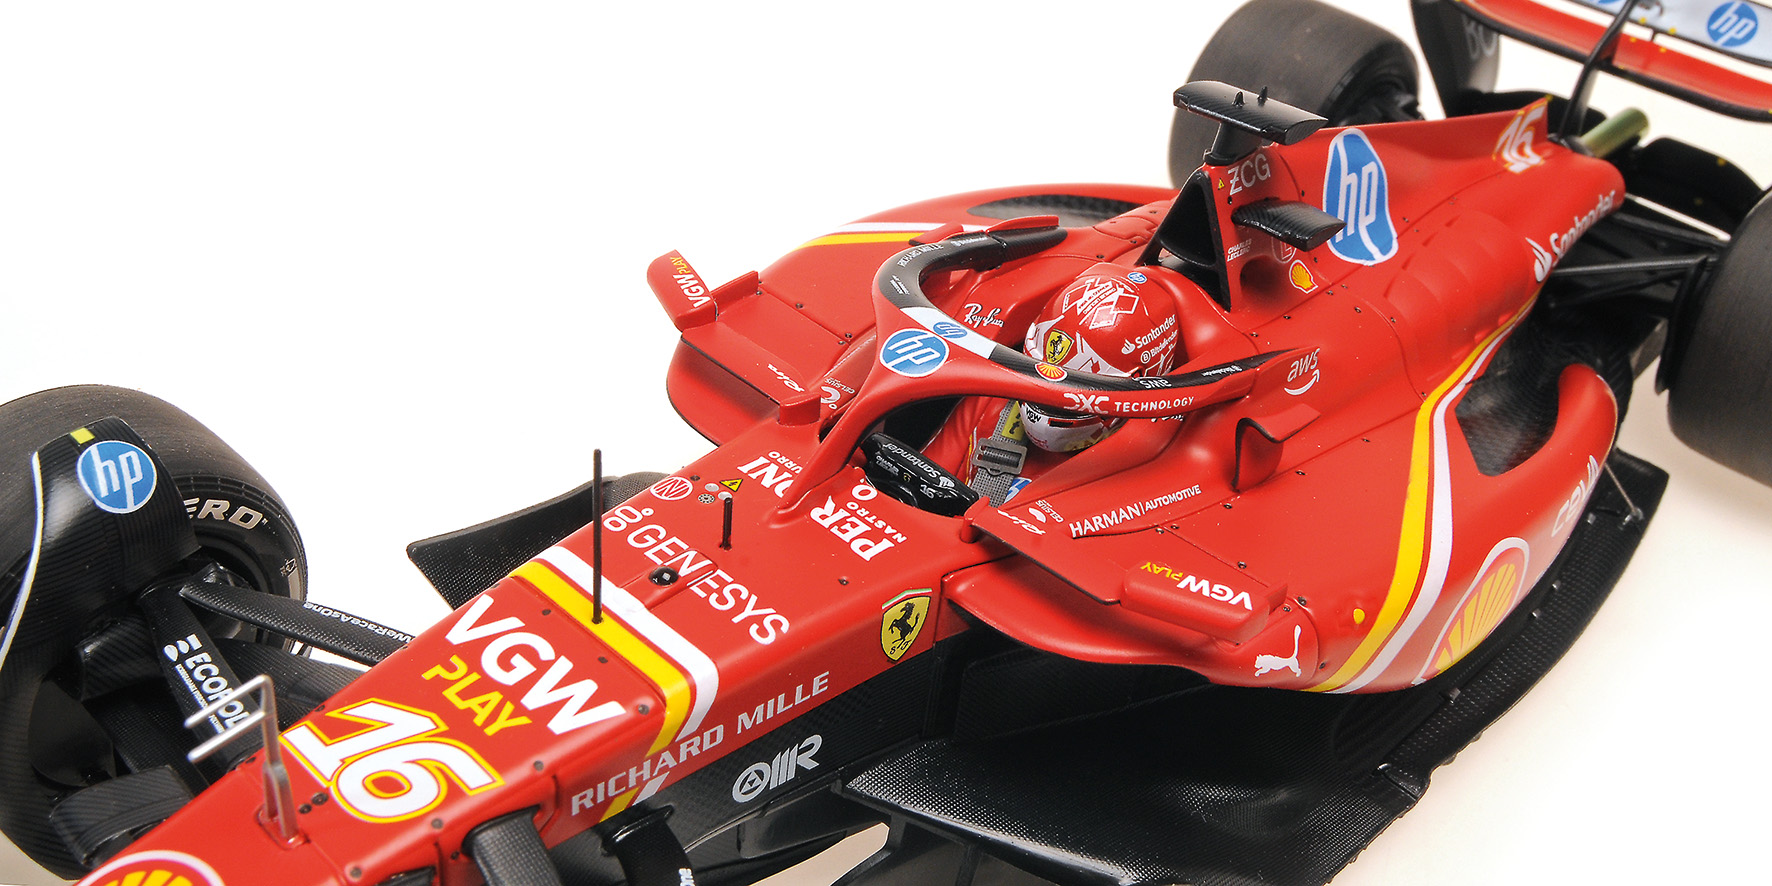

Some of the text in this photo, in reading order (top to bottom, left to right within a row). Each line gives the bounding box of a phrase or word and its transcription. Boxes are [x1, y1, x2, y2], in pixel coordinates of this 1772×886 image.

[1709, 3, 1757, 46] hp
[1493, 99, 1547, 174] 16
[1334, 136, 1387, 261] hp
[1549, 189, 1617, 262] Santander
[670, 256, 691, 275] PLAY
[672, 274, 711, 308] VGW
[886, 331, 944, 372] hp
[1135, 314, 1176, 349] Santander
[1287, 347, 1321, 382] aws
[1114, 396, 1195, 413] TECHNOLOGY
[92, 444, 143, 509] hp
[882, 443, 942, 479] Santander
[846, 501, 908, 544] NASTRO
[1035, 500, 1065, 523] CELSIUS
[1068, 484, 1202, 538] HARMAN AUTOMOTIVE
[626, 523, 790, 646] GENESYS
[1140, 561, 1184, 582] PLAY
[1176, 574, 1253, 611] VGW
[444, 594, 627, 736] VGW
[421, 654, 533, 736] PLAY
[278, 697, 507, 824] 16
[570, 670, 831, 817] RICHARD MILLE
